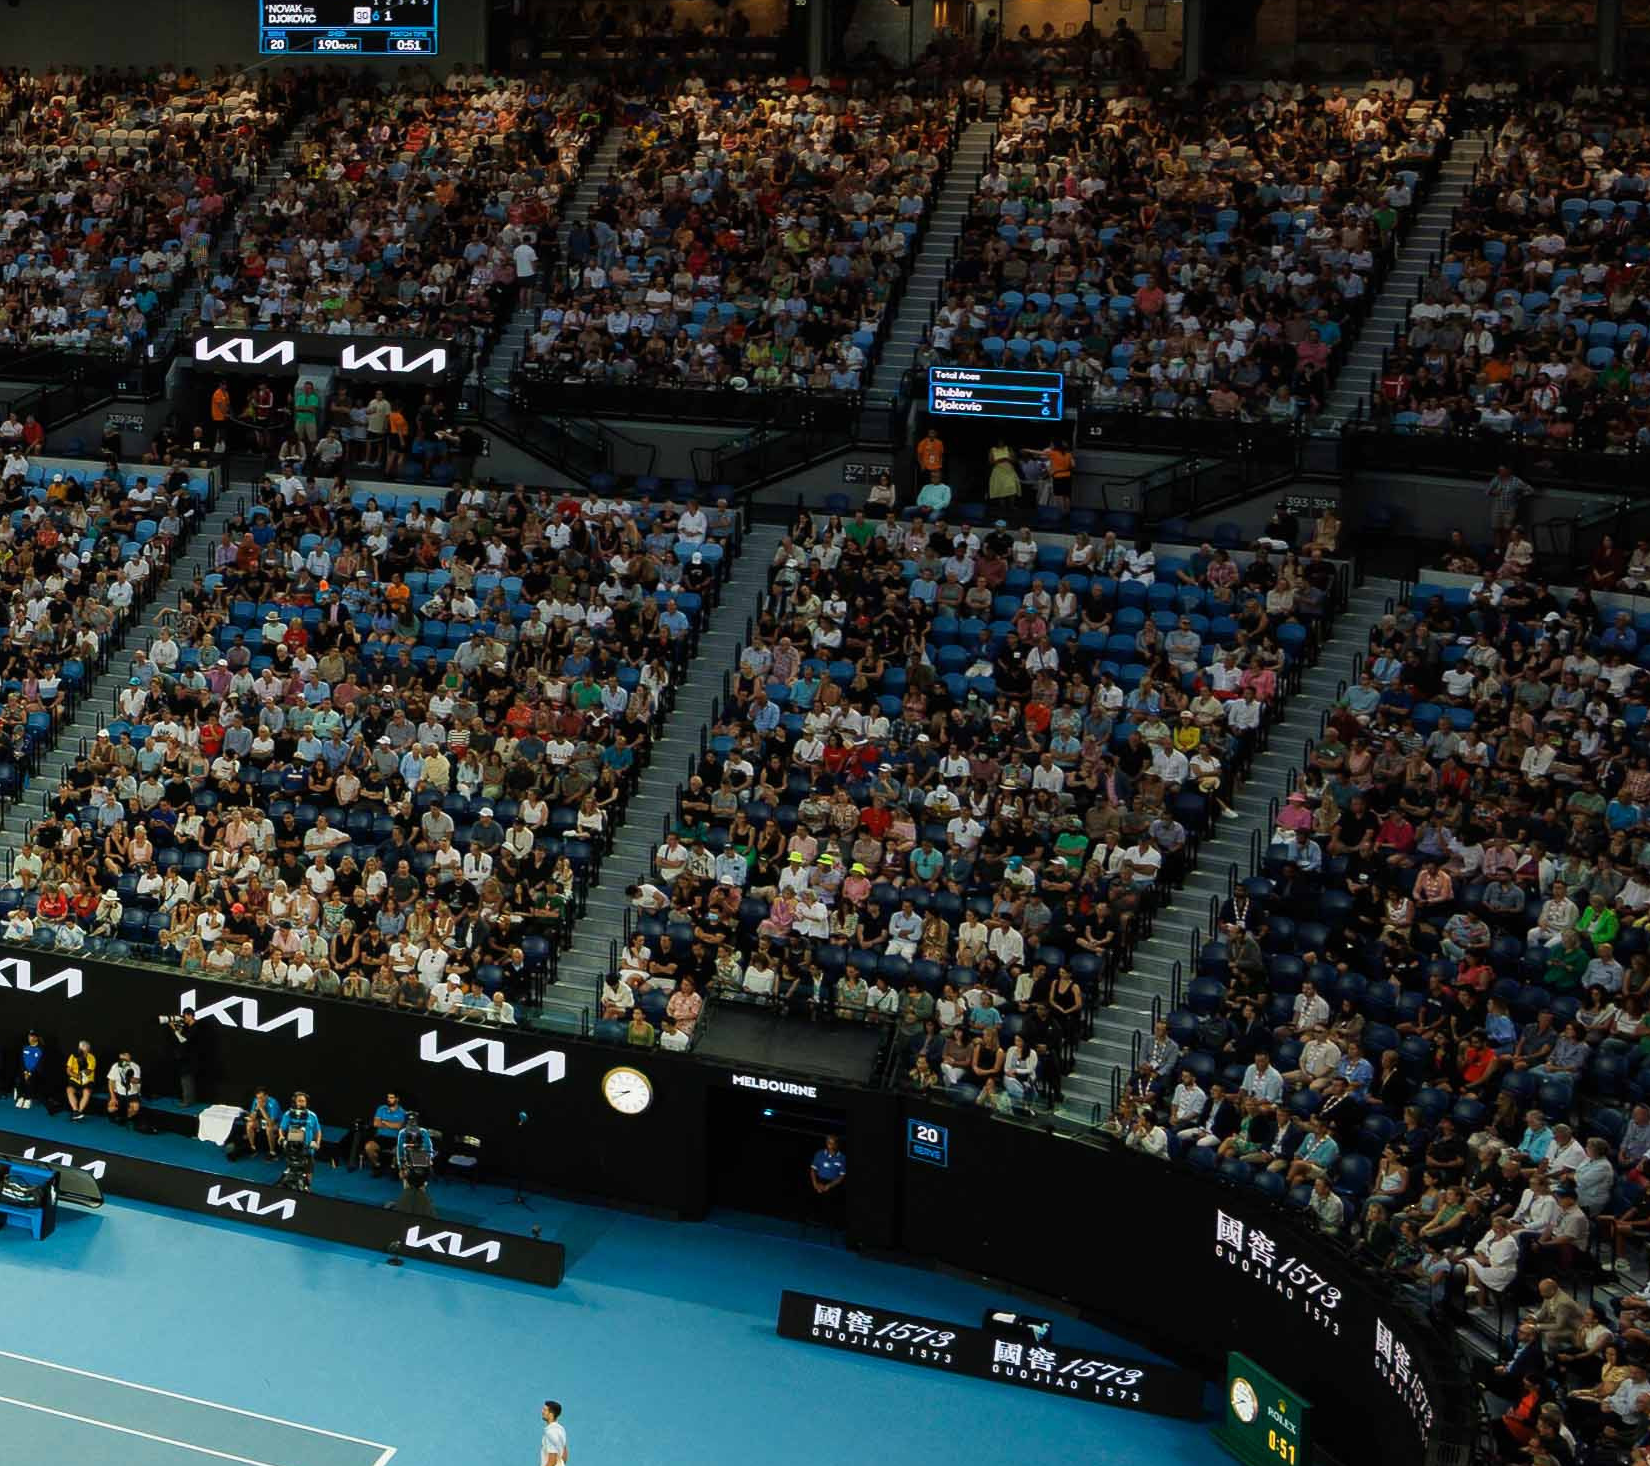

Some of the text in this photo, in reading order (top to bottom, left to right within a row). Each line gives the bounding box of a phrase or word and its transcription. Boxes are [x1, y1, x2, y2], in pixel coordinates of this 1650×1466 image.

[268, 4, 302, 14] NOVAK
[268, 14, 317, 24] DJOKOVIC
[356, 10, 393, 21] 30 6 1
[270, 39, 285, 50] 20
[396, 39, 422, 51] 0:51
[195, 336, 295, 366] KIA
[341, 344, 447, 374] KIA
[935, 387, 973, 398] Rublev
[935, 399, 1050, 416] Djokovic 6
[180, 988, 314, 1039] KIA
[419, 1029, 566, 1083] KIA
[732, 1074, 817, 1099] MELBOURNE
[916, 1125, 939, 1143] 20
[206, 1184, 297, 1220] KIA
[405, 1225, 501, 1263] KIA
[1215, 1245, 1340, 1336] GUOJIAO 1573
[812, 1326, 953, 1364] GUOJIAO 1573
[992, 1363, 1141, 1402] GUOJIAO 1573
[1267, 1406, 1297, 1435] ROLEX
[1268, 1429, 1296, 1466] 0:51
